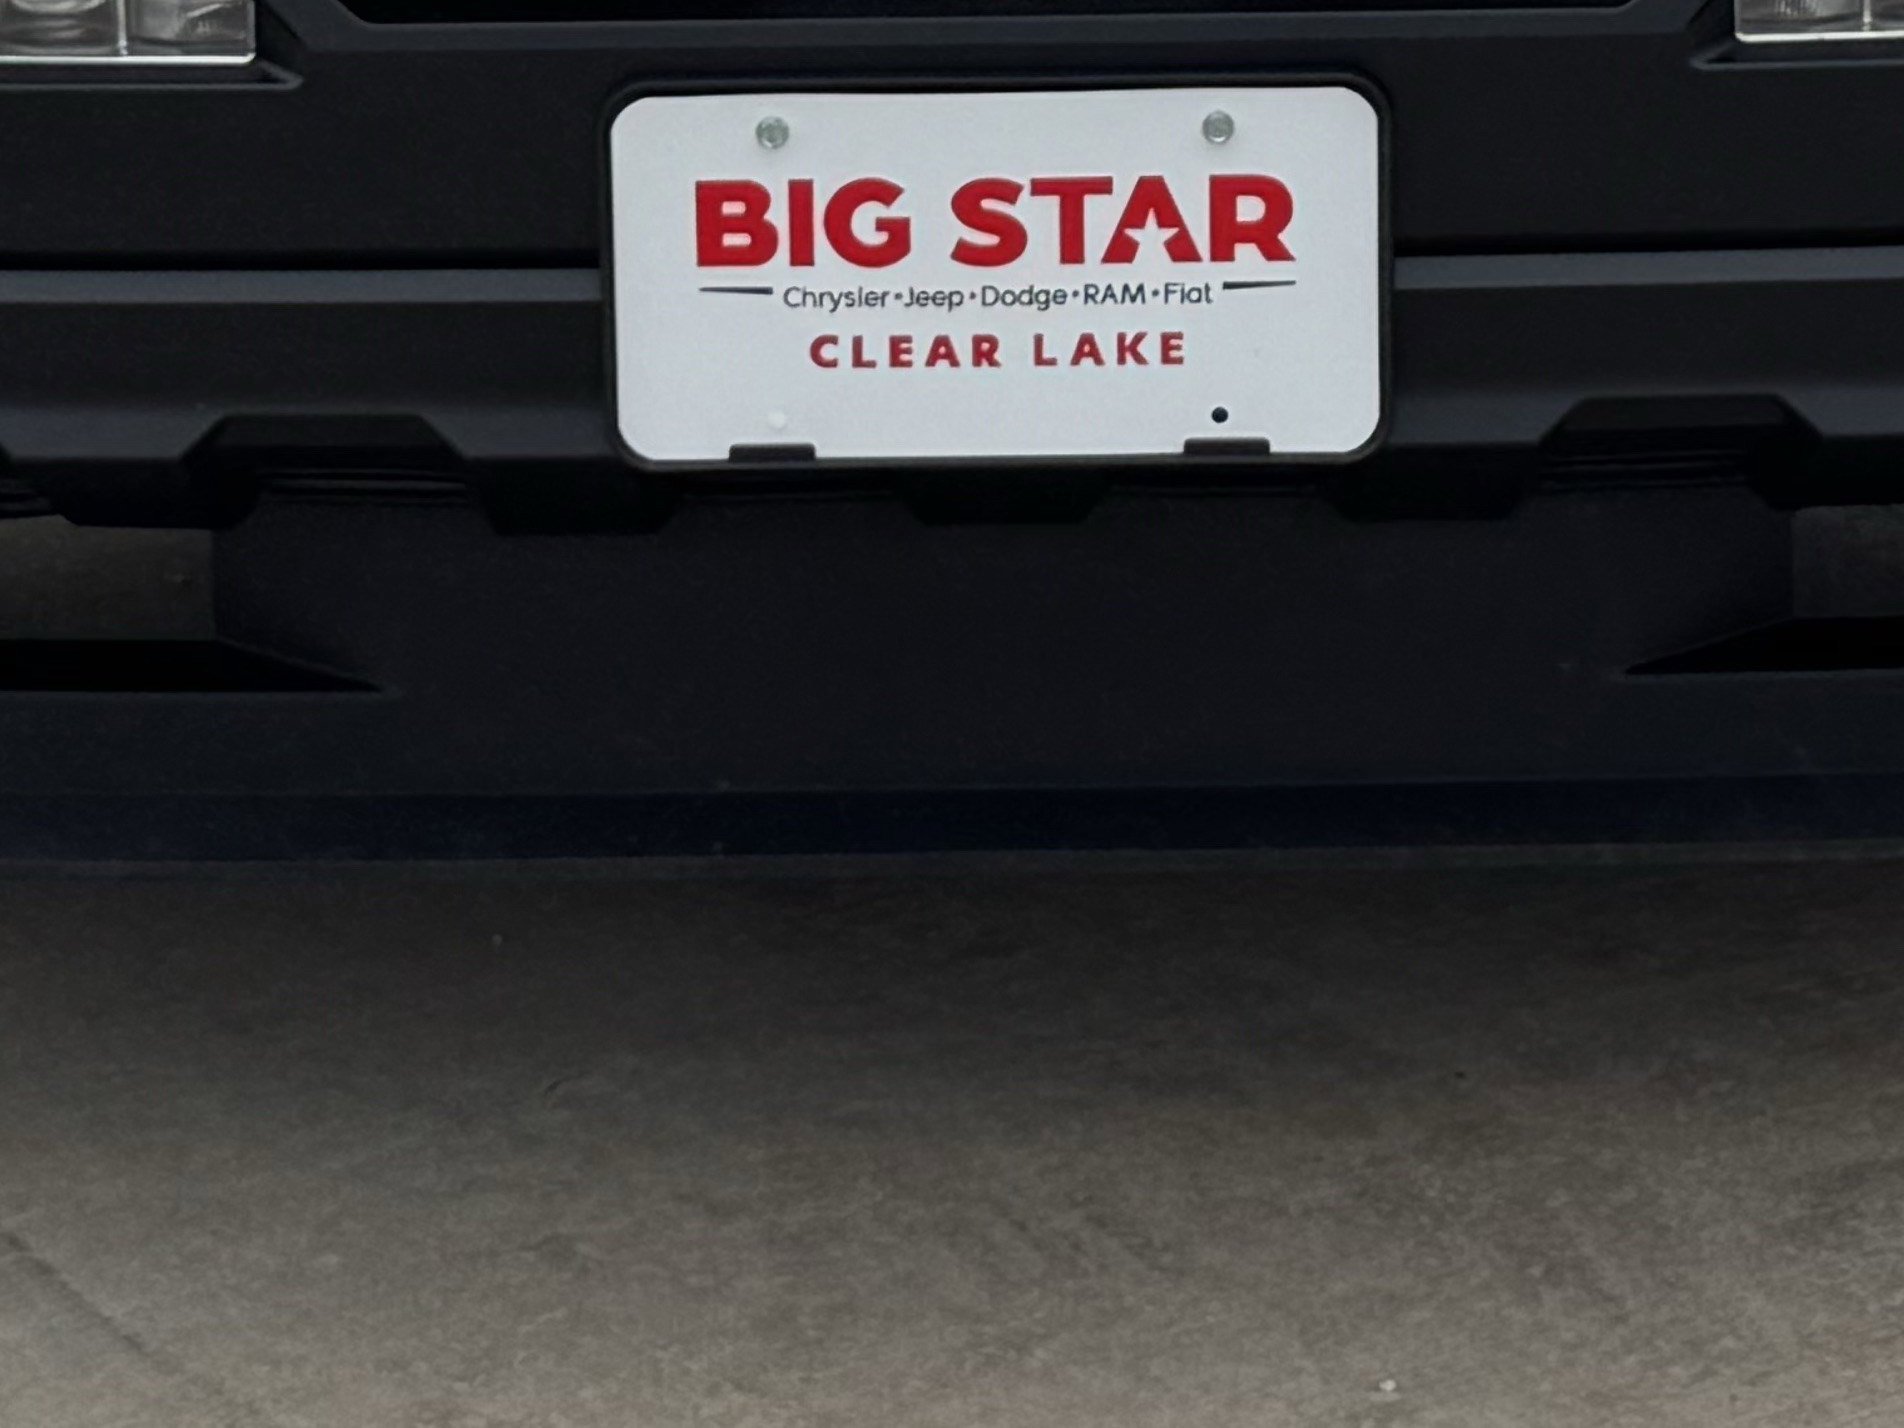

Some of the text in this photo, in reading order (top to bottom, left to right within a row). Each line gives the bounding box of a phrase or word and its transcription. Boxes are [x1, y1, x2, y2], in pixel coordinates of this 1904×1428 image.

[694, 173, 1295, 269] BIG STAR
[809, 331, 1185, 369] CLEAR LAKE
